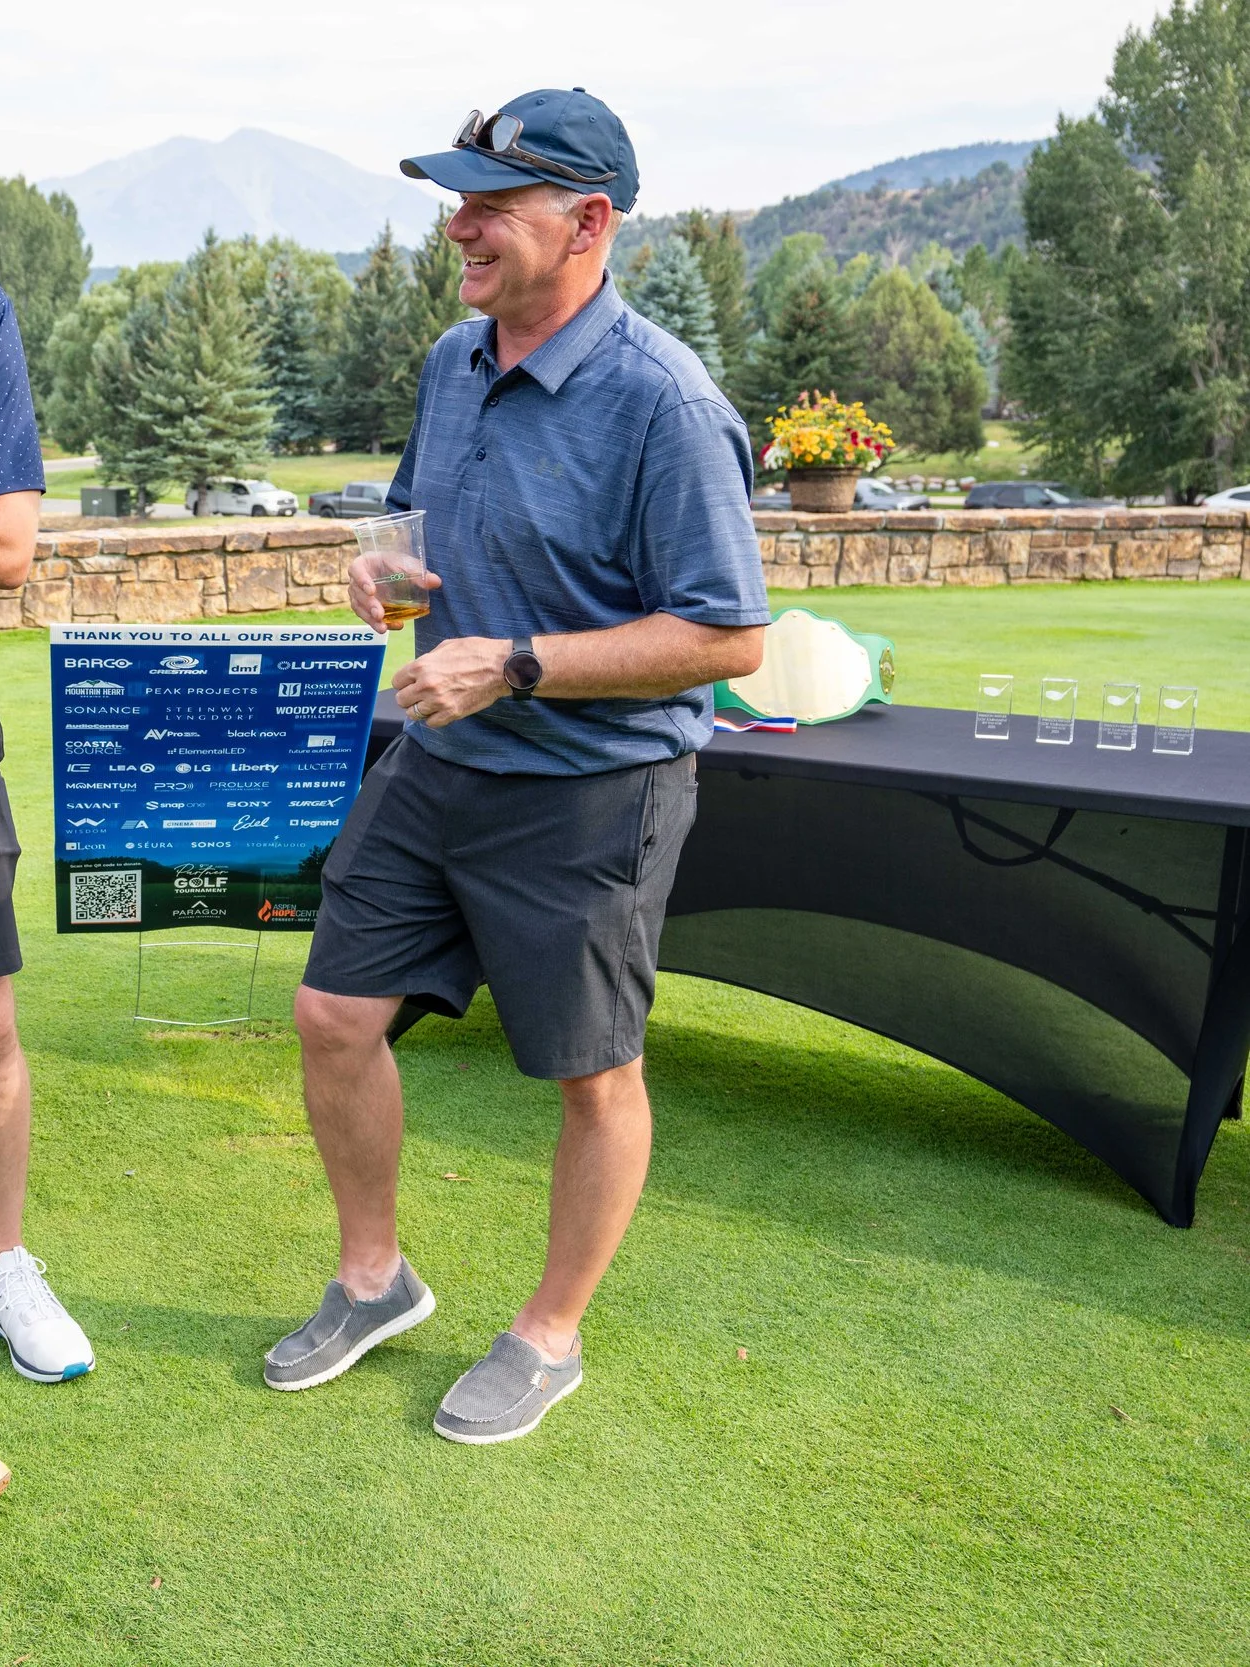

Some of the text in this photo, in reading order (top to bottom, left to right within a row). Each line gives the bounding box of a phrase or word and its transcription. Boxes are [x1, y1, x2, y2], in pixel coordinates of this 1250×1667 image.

[63, 632, 374, 641] THANK YOU TO ALL OUR SPONSORS
[65, 658, 133, 669] BARCO
[292, 660, 368, 670] LUTRON
[276, 705, 359, 714] WOODY CREEK
[231, 763, 279, 773] Liberty
[298, 762, 348, 771] LUCETTA
[288, 797, 344, 807] SURGEX
[233, 815, 270, 831] Edel
[300, 819, 339, 828] legrand
[78, 842, 106, 850] Leon
[174, 877, 228, 888] GOLF
